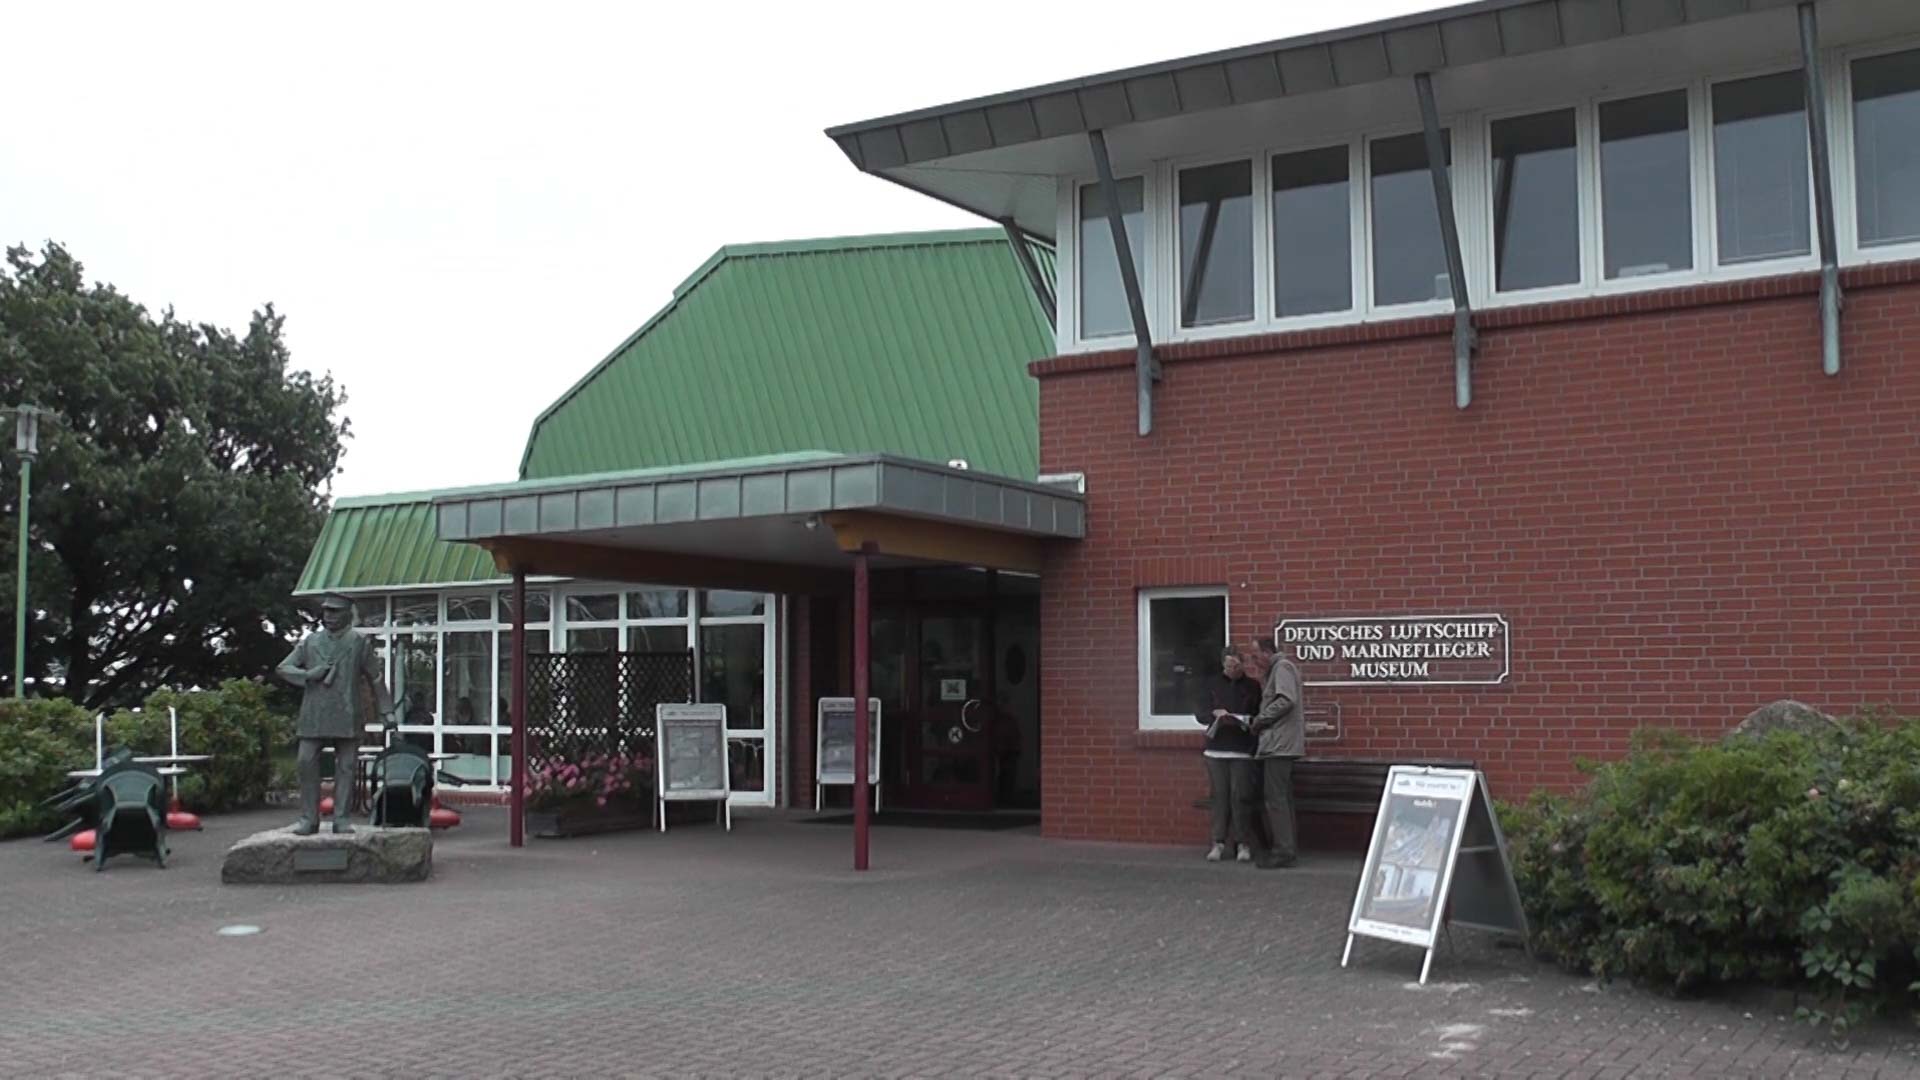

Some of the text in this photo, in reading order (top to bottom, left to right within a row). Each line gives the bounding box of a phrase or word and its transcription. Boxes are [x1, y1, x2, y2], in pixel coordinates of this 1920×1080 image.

[1284, 622, 1502, 642] DEUTSCHES LUFTSCHIFF-
[1296, 641, 1494, 660] UND MARINEFLIEGER-
[1350, 661, 1429, 677] MUSEUM
